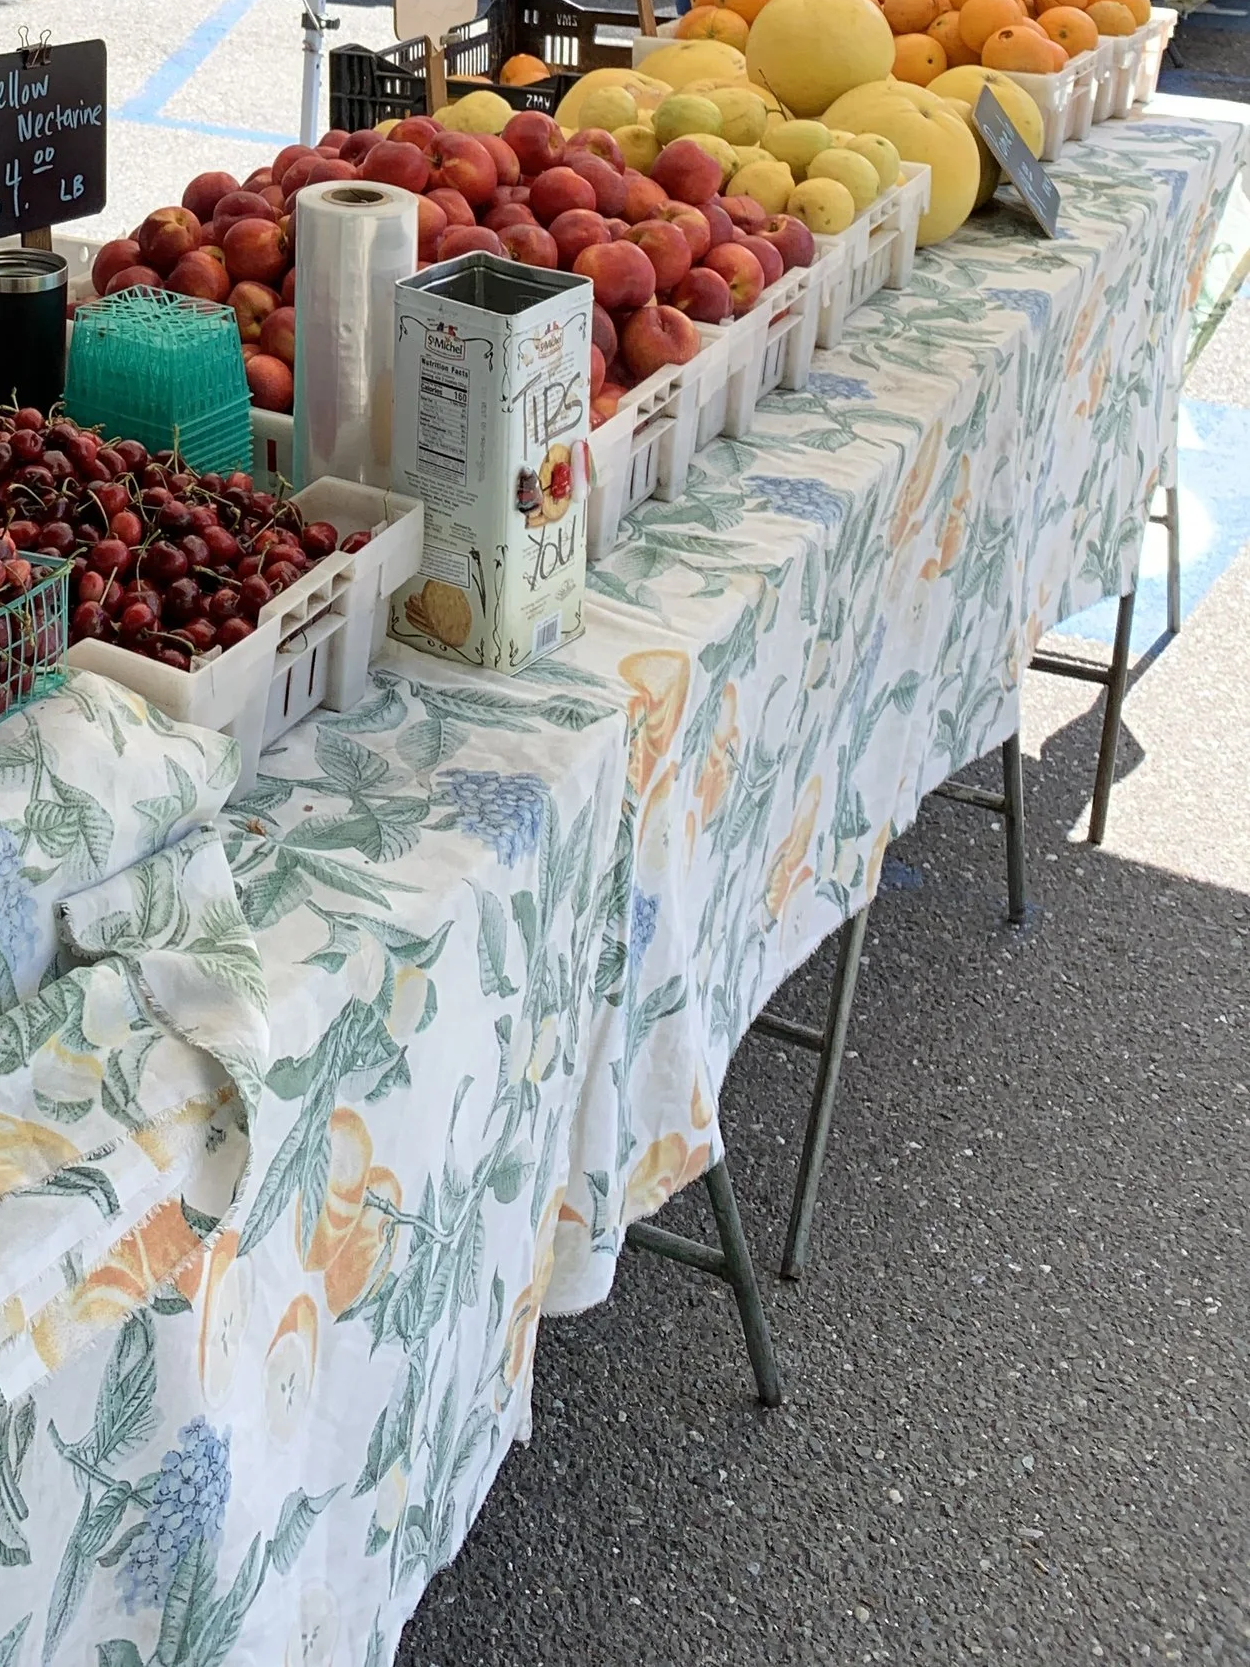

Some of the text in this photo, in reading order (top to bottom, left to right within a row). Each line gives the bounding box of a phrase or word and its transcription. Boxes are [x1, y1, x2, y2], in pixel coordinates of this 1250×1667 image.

[556, 13, 578, 27] VMS
[17, 102, 103, 143] Nectarine
[59, 174, 85, 203] LB
[435, 337, 463, 355] Michel
[421, 357, 449, 372] Nutrition
[451, 366, 468, 378] Facts
[454, 391, 468, 402] 160
[512, 371, 583, 463] TIPS
